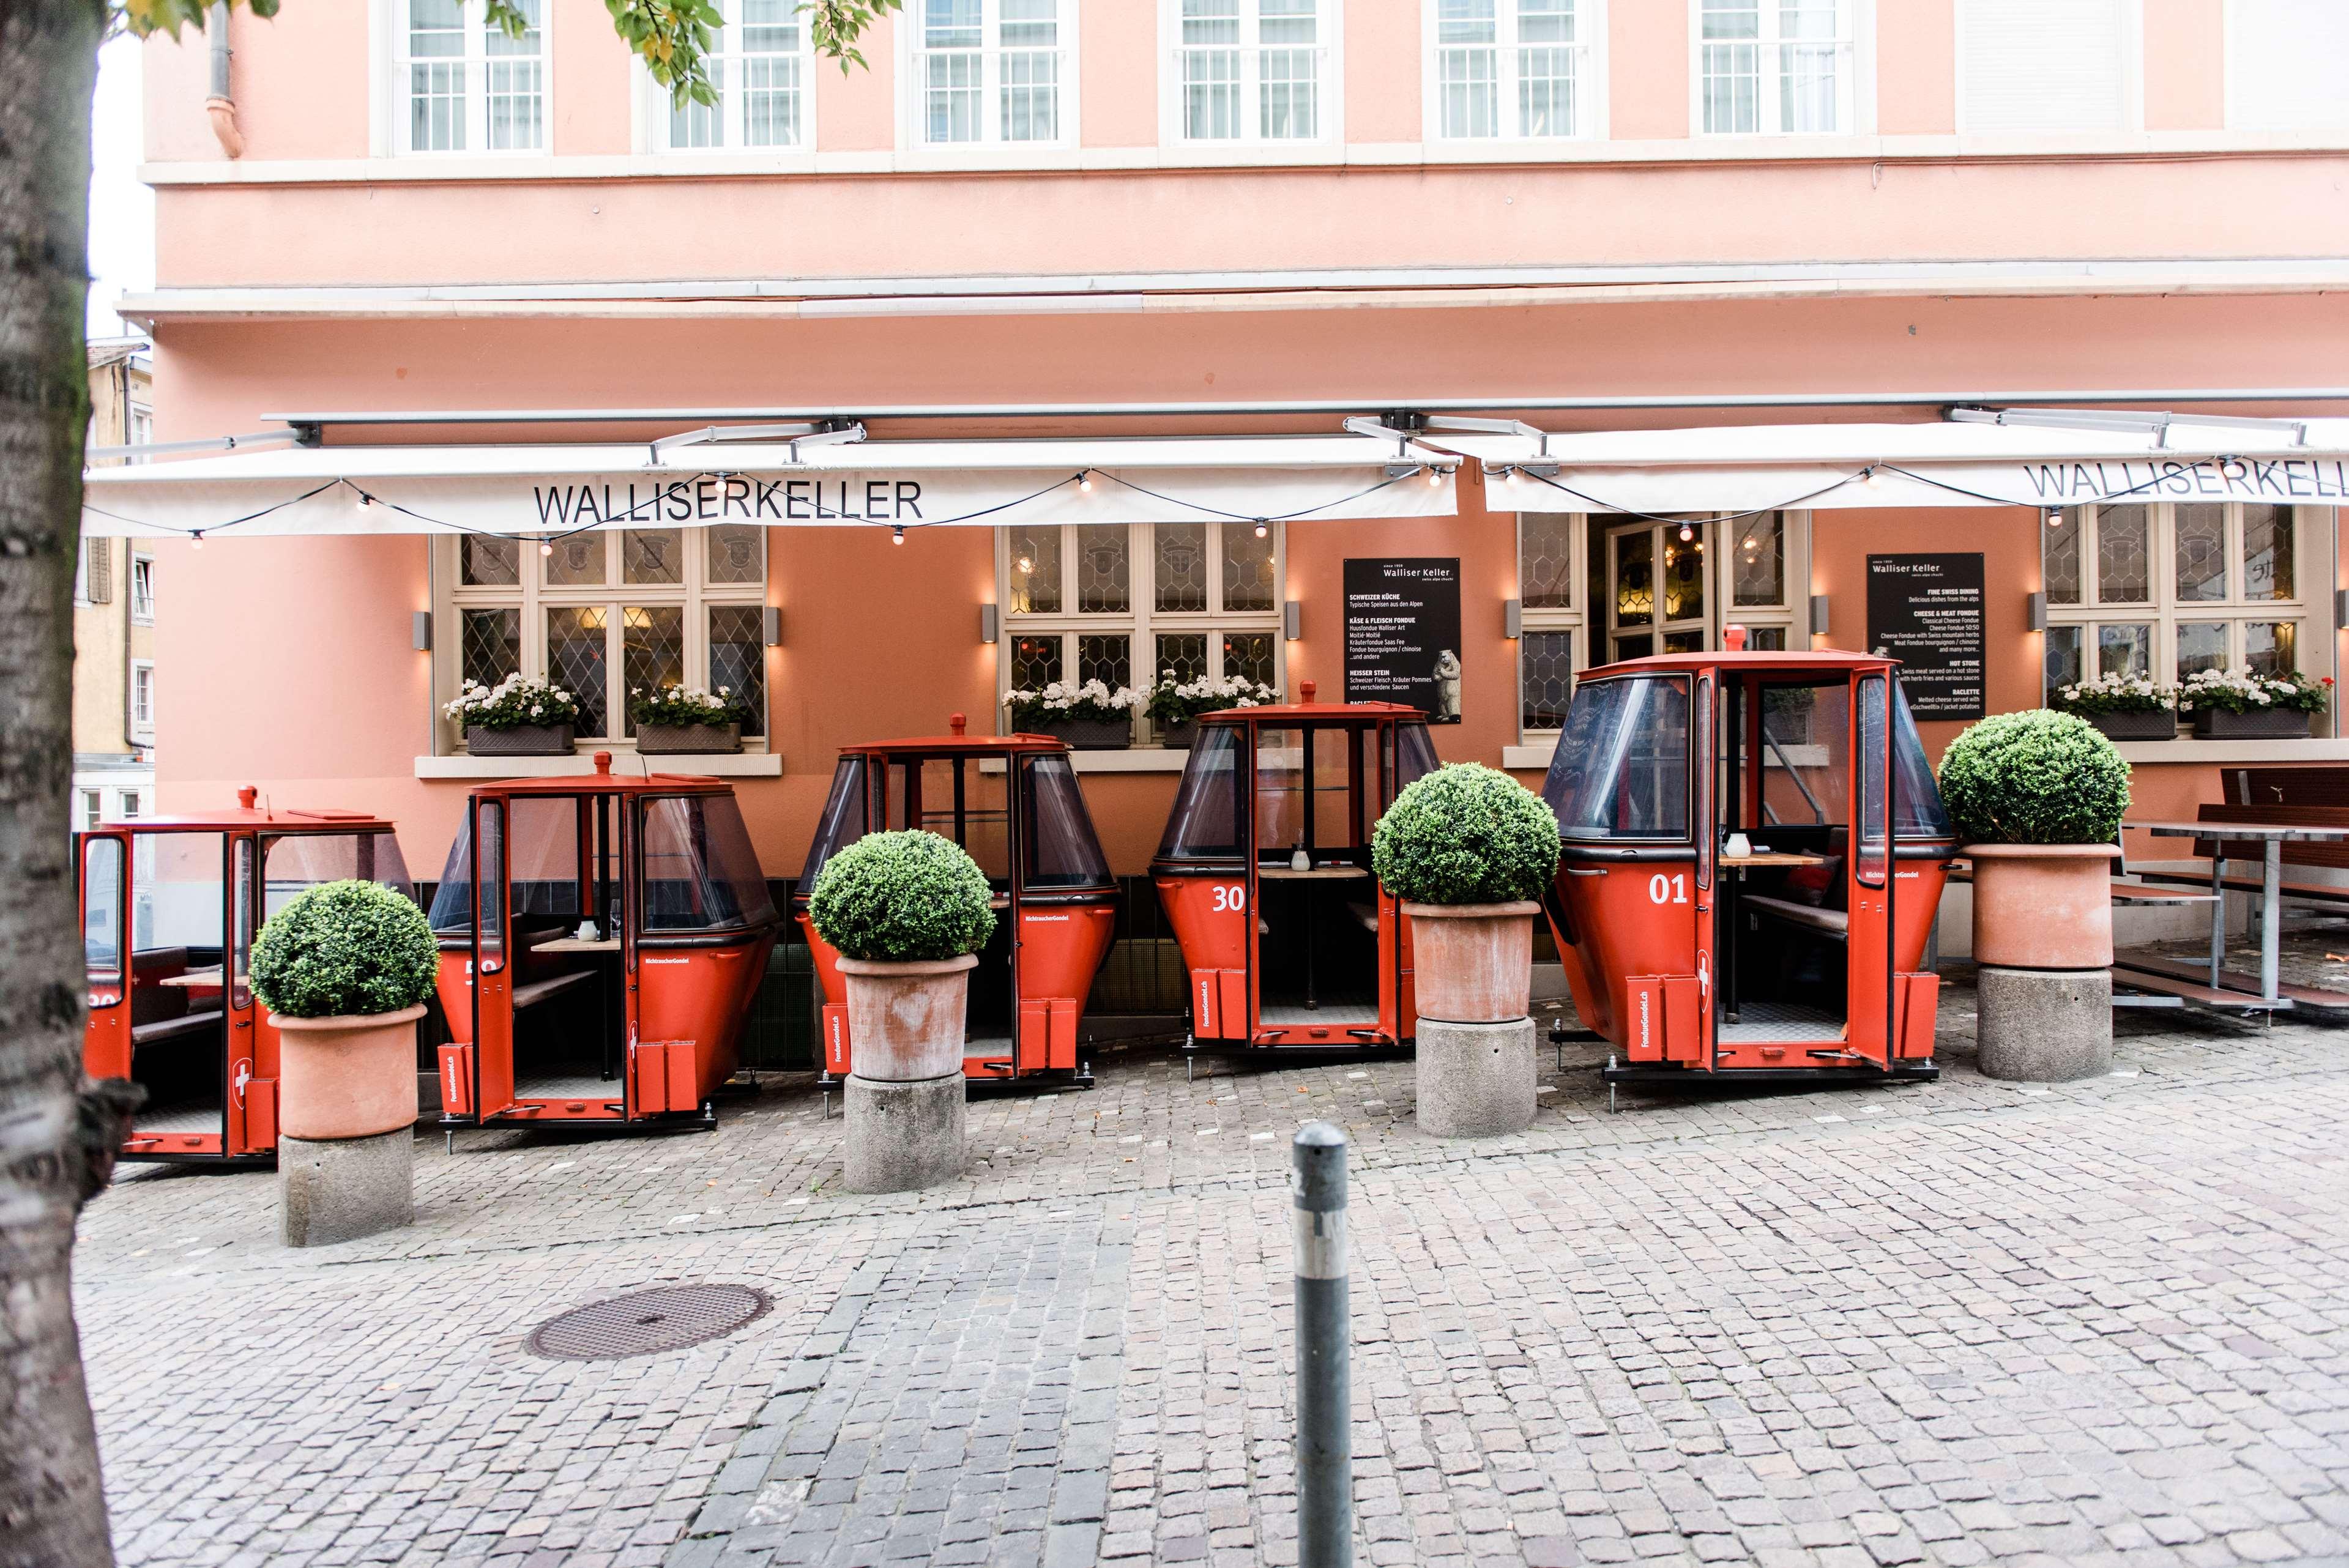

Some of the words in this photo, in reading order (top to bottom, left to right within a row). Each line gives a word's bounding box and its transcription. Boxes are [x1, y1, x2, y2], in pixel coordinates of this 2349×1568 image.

[534, 480, 923, 524] WALLISERKELLER
[1213, 886, 1244, 912] 30
[1650, 874, 1687, 904] 01
[1201, 981, 1209, 1027] FondueGondel.ch
[1640, 991, 1649, 1048] FondueGondel.ch
[832, 1016, 841, 1062] FondueGondel.ch
